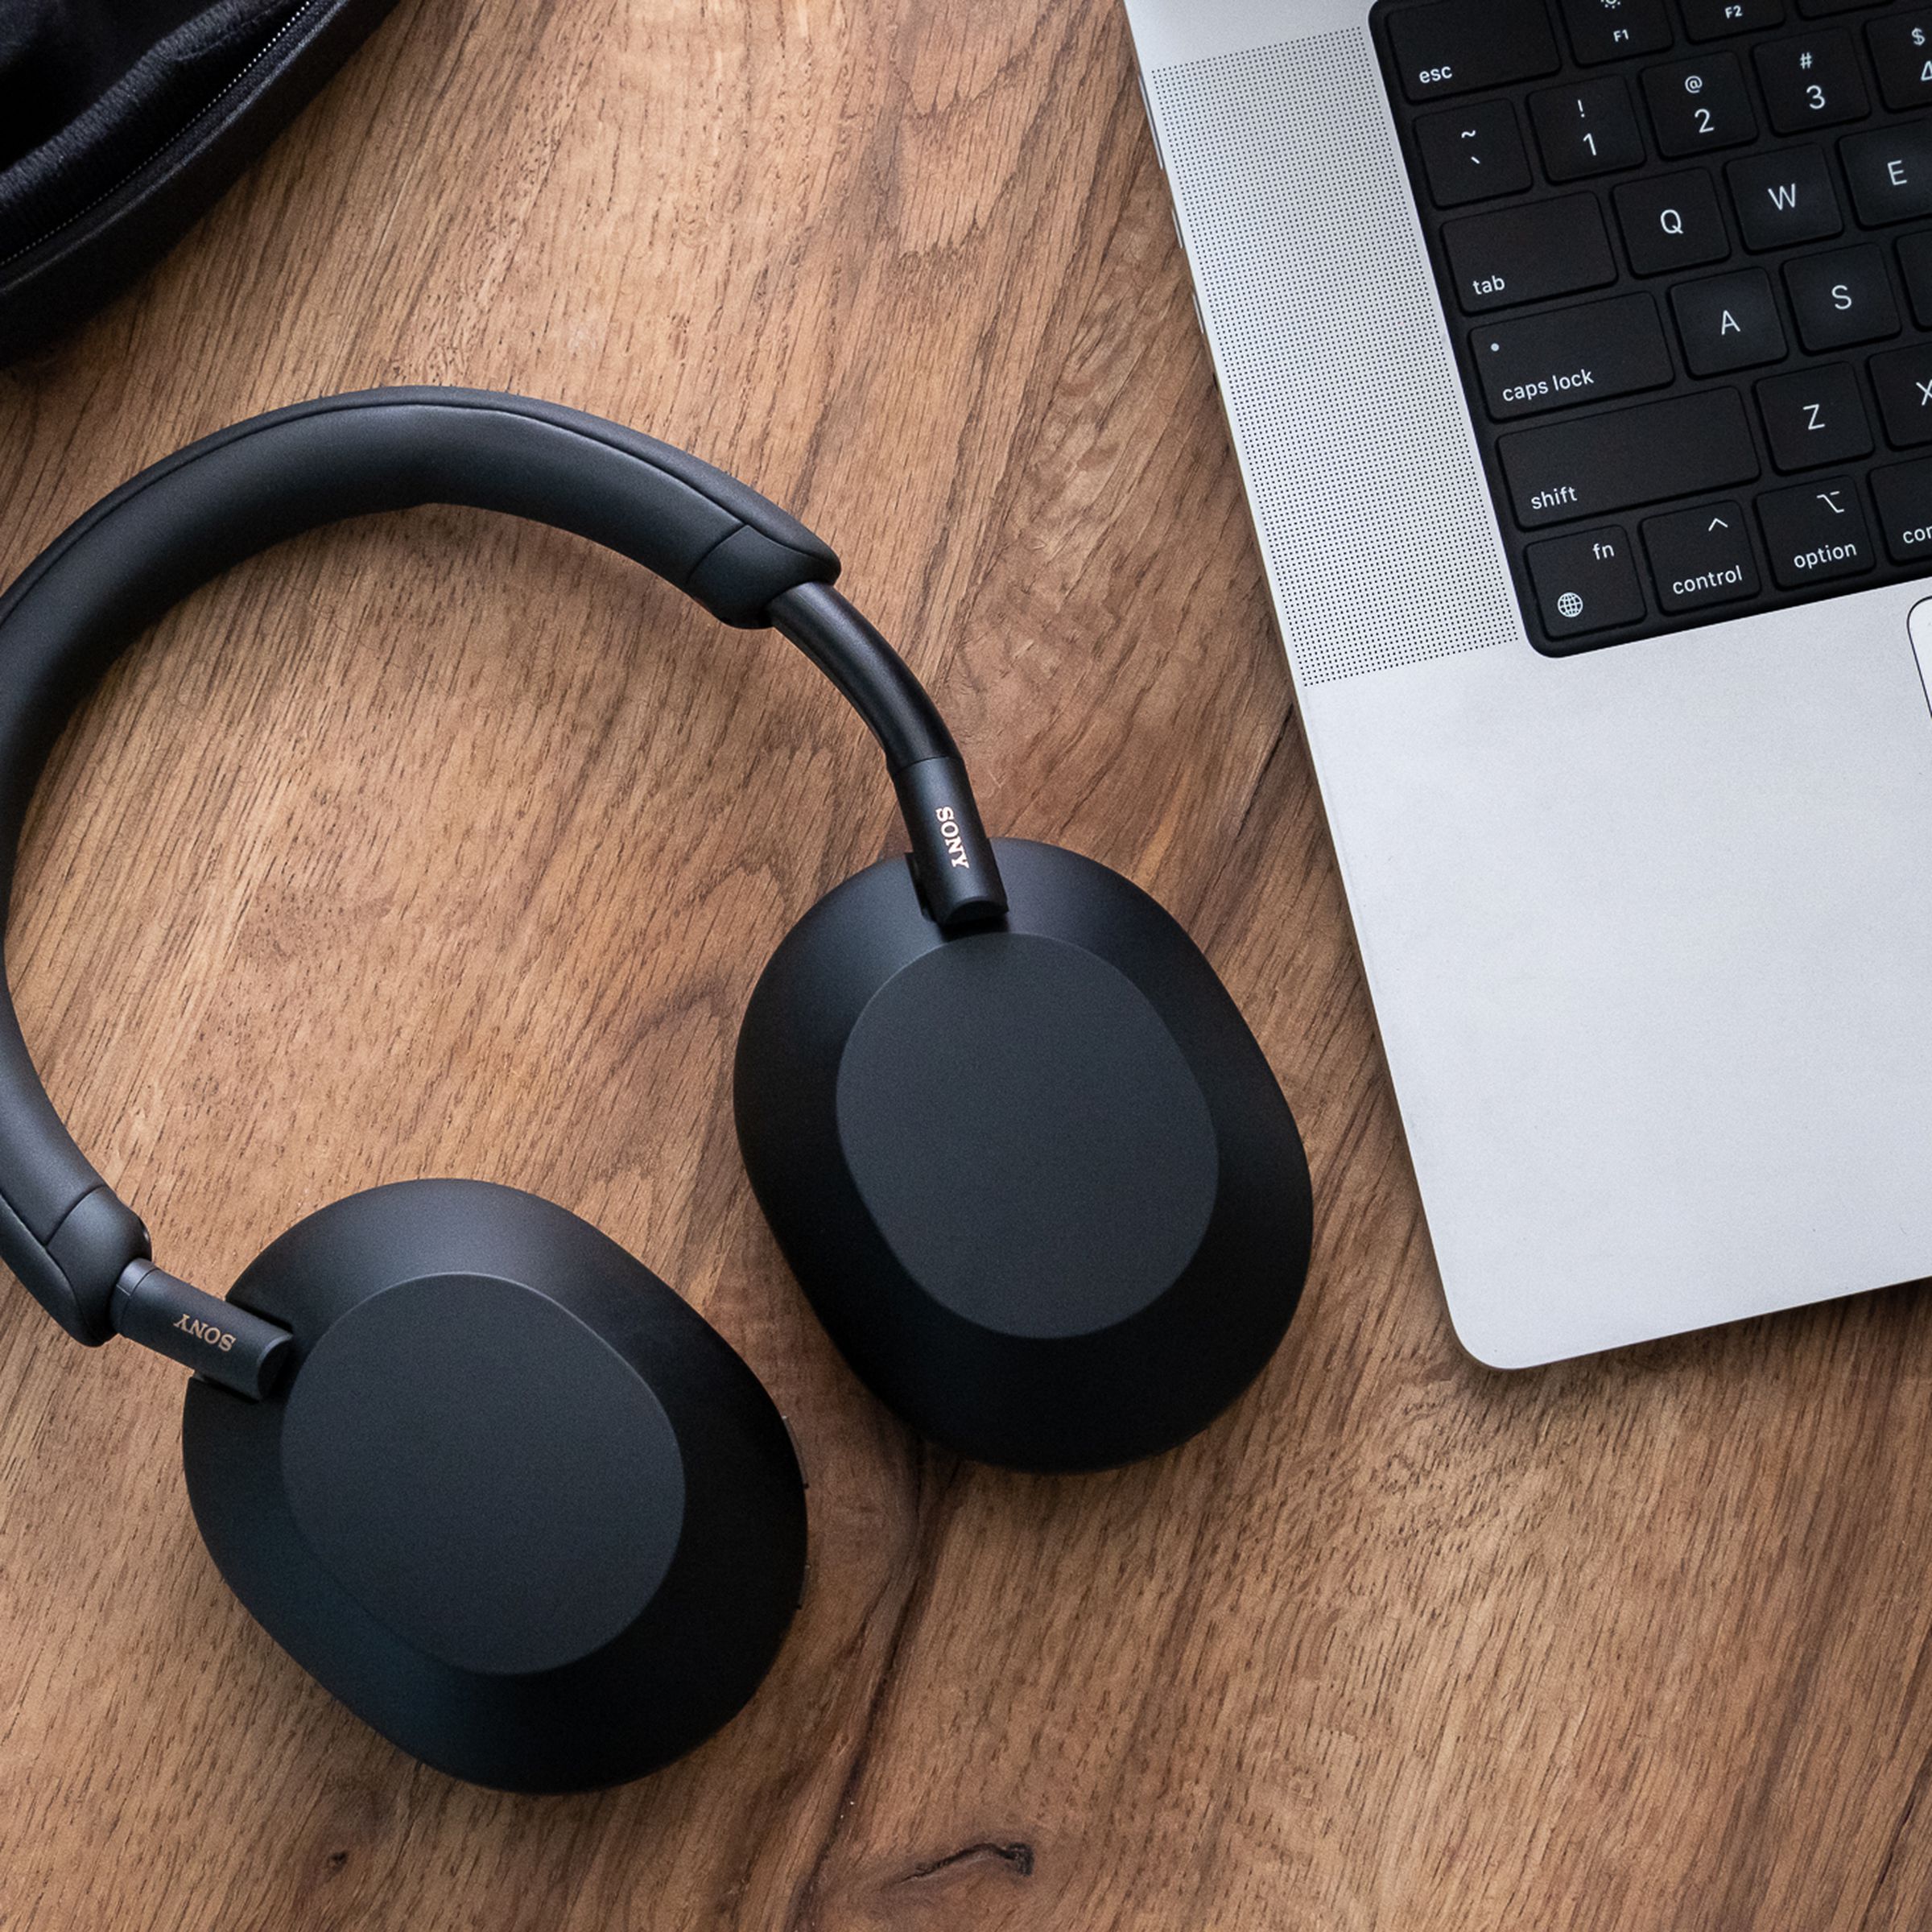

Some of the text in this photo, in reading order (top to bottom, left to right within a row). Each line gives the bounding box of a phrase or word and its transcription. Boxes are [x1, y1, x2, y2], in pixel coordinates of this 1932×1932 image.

[1724, 5, 1743, 19] F2
[1613, 29, 1629, 43] F1
[1911, 27, 1926, 46] $
[1800, 52, 1812, 69] #
[1418, 66, 1453, 84] esc
[1684, 75, 1703, 94] @
[1577, 99, 1585, 118] !
[1806, 85, 1826, 109] 3
[1694, 108, 1715, 134] 2
[1461, 130, 1476, 138] ~
[1583, 133, 1597, 156] 1
[1887, 159, 1908, 186] E
[1767, 183, 1796, 211] W
[1660, 208, 1684, 234] Q
[1472, 275, 1505, 295] tab
[1831, 284, 1852, 310] S
[1721, 309, 1741, 336] A
[1502, 368, 1595, 402] caps lock
[1802, 403, 1826, 431] Z
[1530, 485, 1578, 510] shift
[1592, 543, 1615, 560] fn
[1794, 543, 1857, 570] option
[1672, 564, 1743, 595] control
[935, 806, 970, 869] SONY
[172, 1313, 237, 1352] SONY
